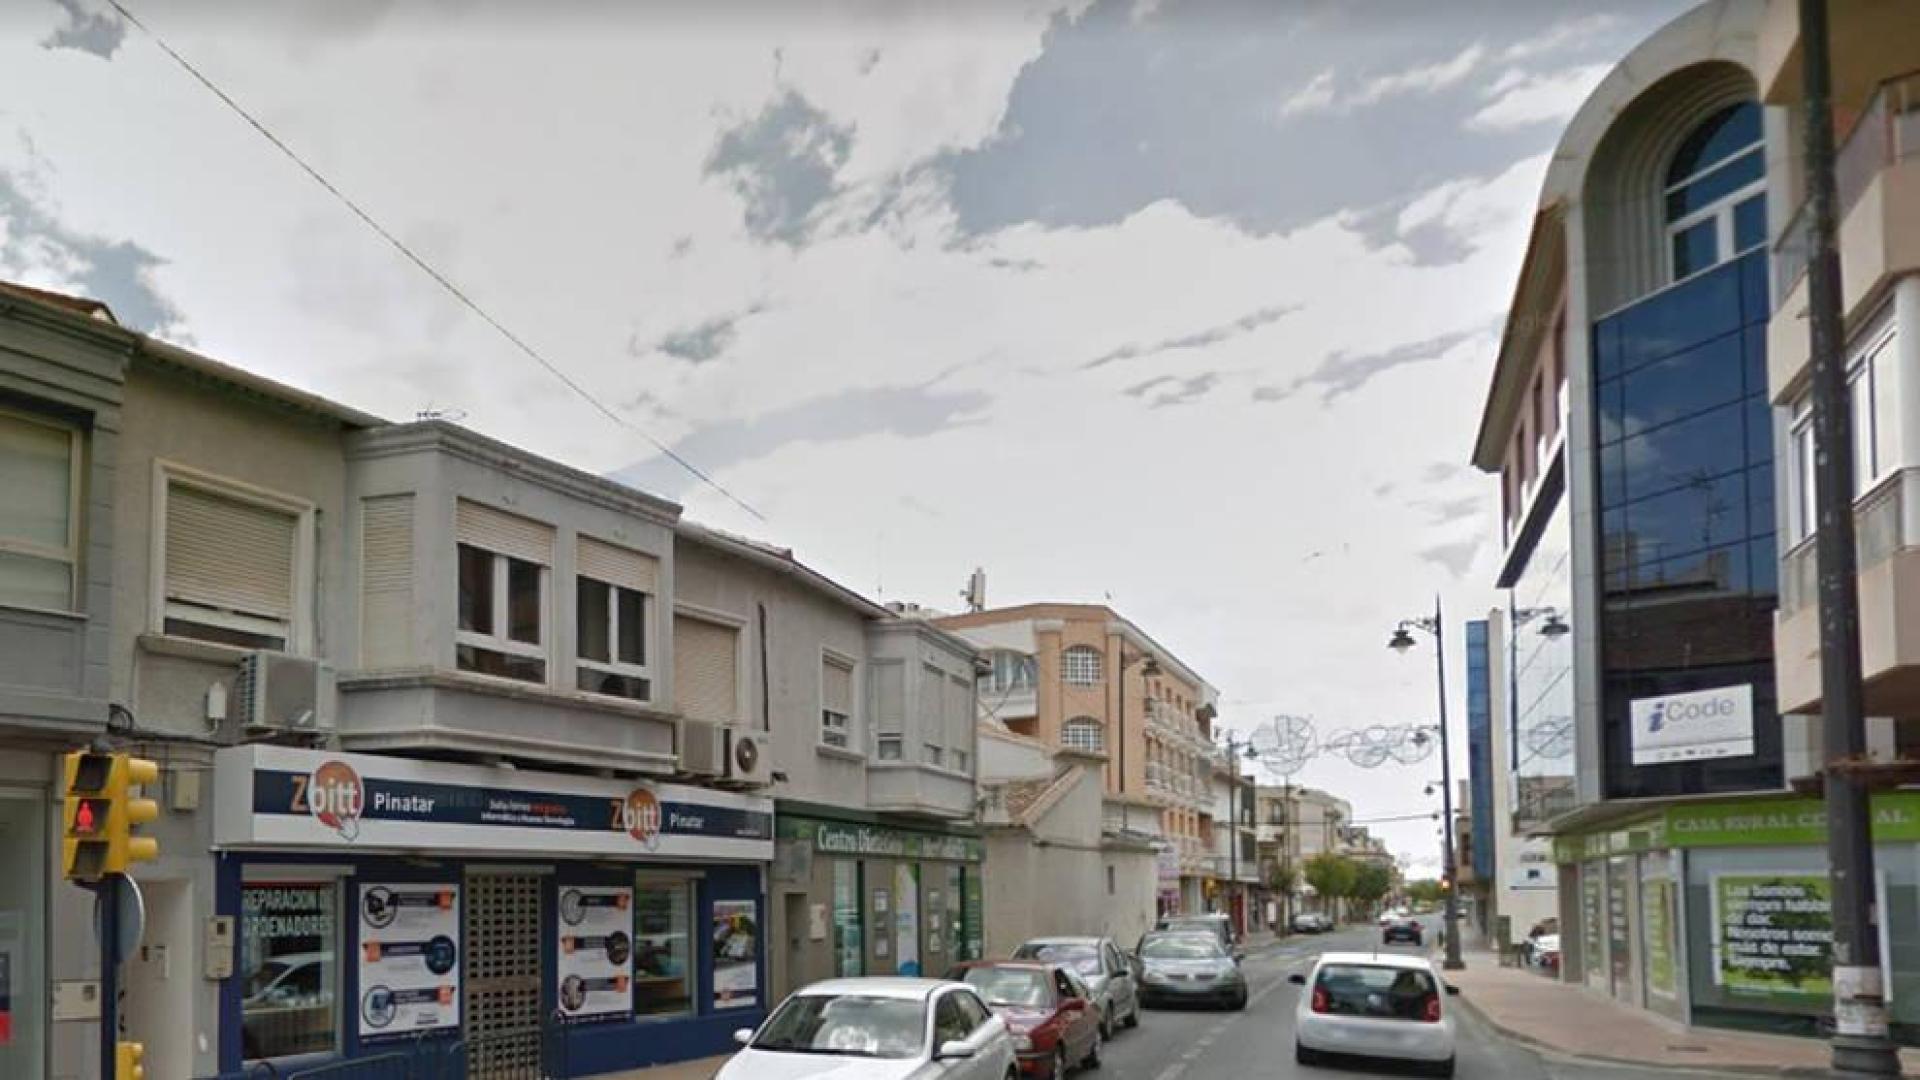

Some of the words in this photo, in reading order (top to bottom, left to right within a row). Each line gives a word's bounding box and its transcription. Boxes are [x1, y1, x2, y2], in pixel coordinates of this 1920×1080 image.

[1648, 698, 1735, 733] iCode
[374, 793, 435, 813] Pinatar
[818, 824, 856, 851] Centro
